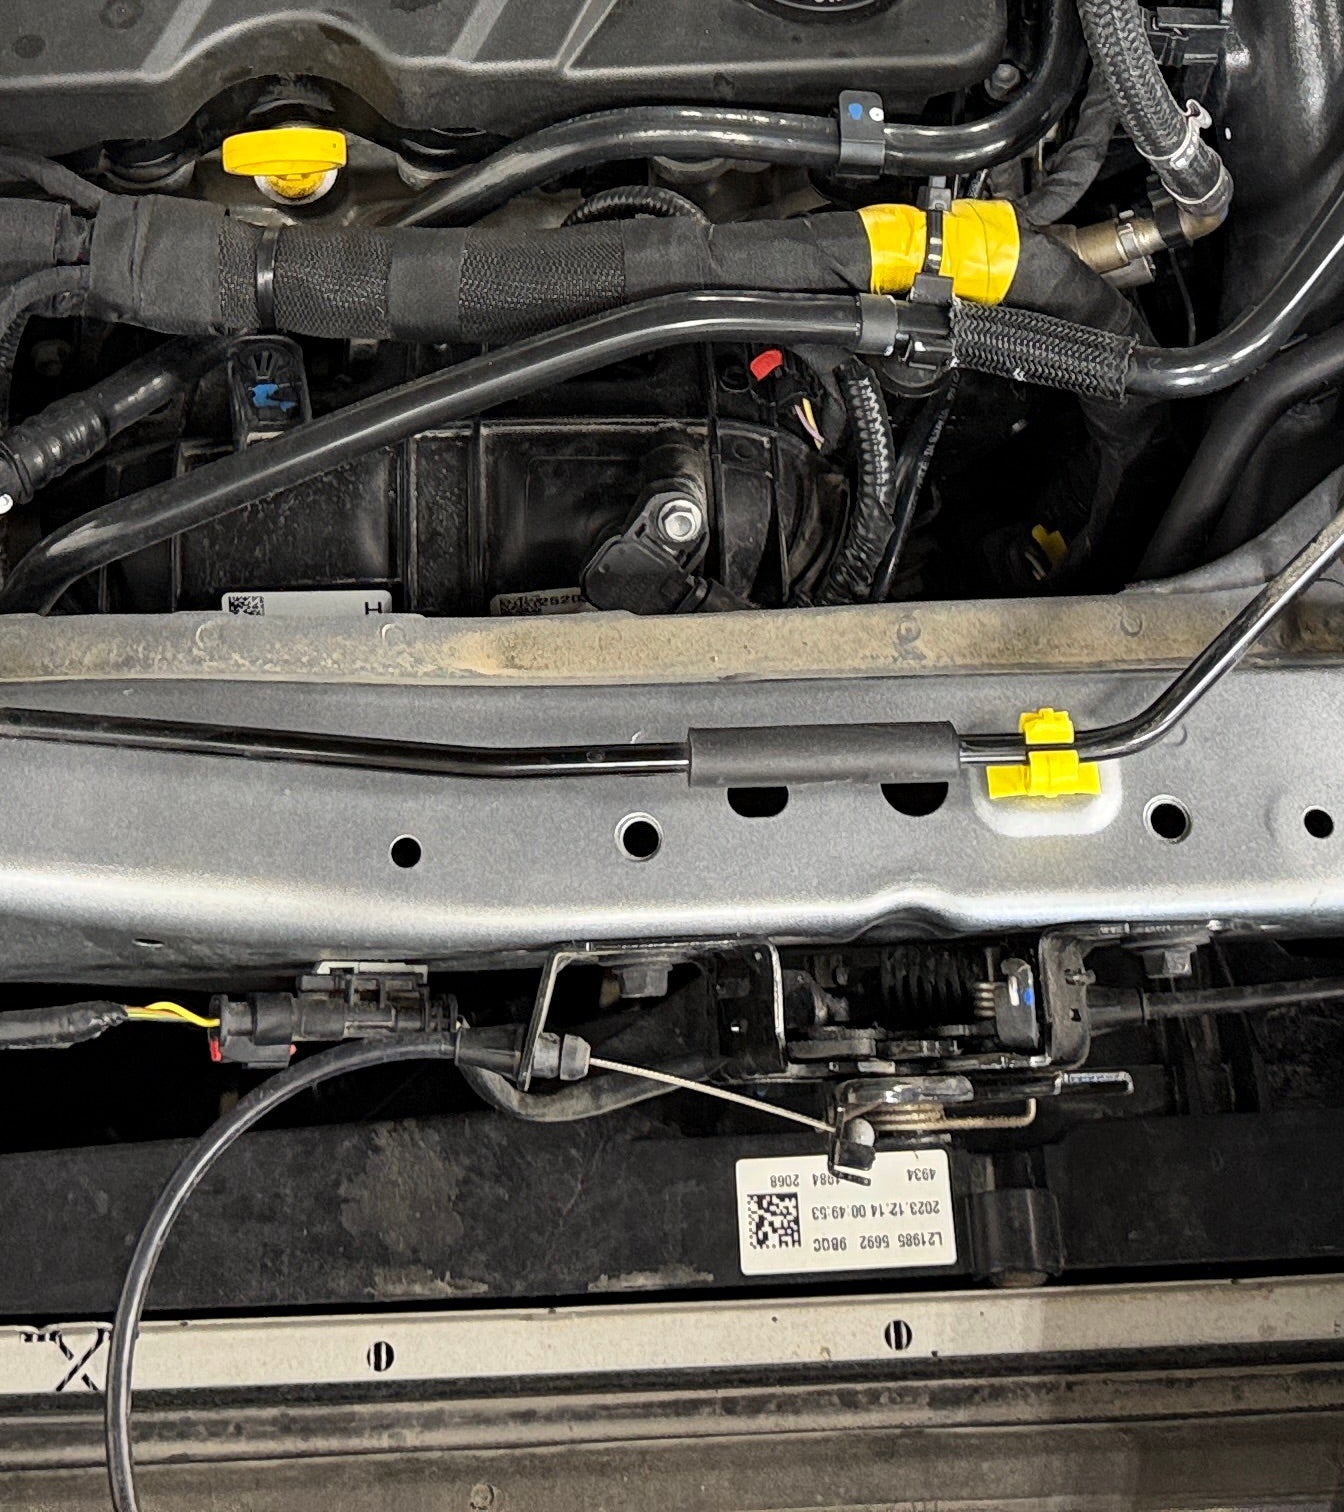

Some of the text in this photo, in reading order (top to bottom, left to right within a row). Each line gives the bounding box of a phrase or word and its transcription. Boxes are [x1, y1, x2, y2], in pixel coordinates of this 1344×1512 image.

[770, 1174, 800, 1188] 2068
[907, 1167, 937, 1183] 4934
[811, 1200, 941, 1221] 2023.12.14 00:49:53
[859, 1235, 890, 1250] 5692
[897, 1231, 944, 1248] L21985
